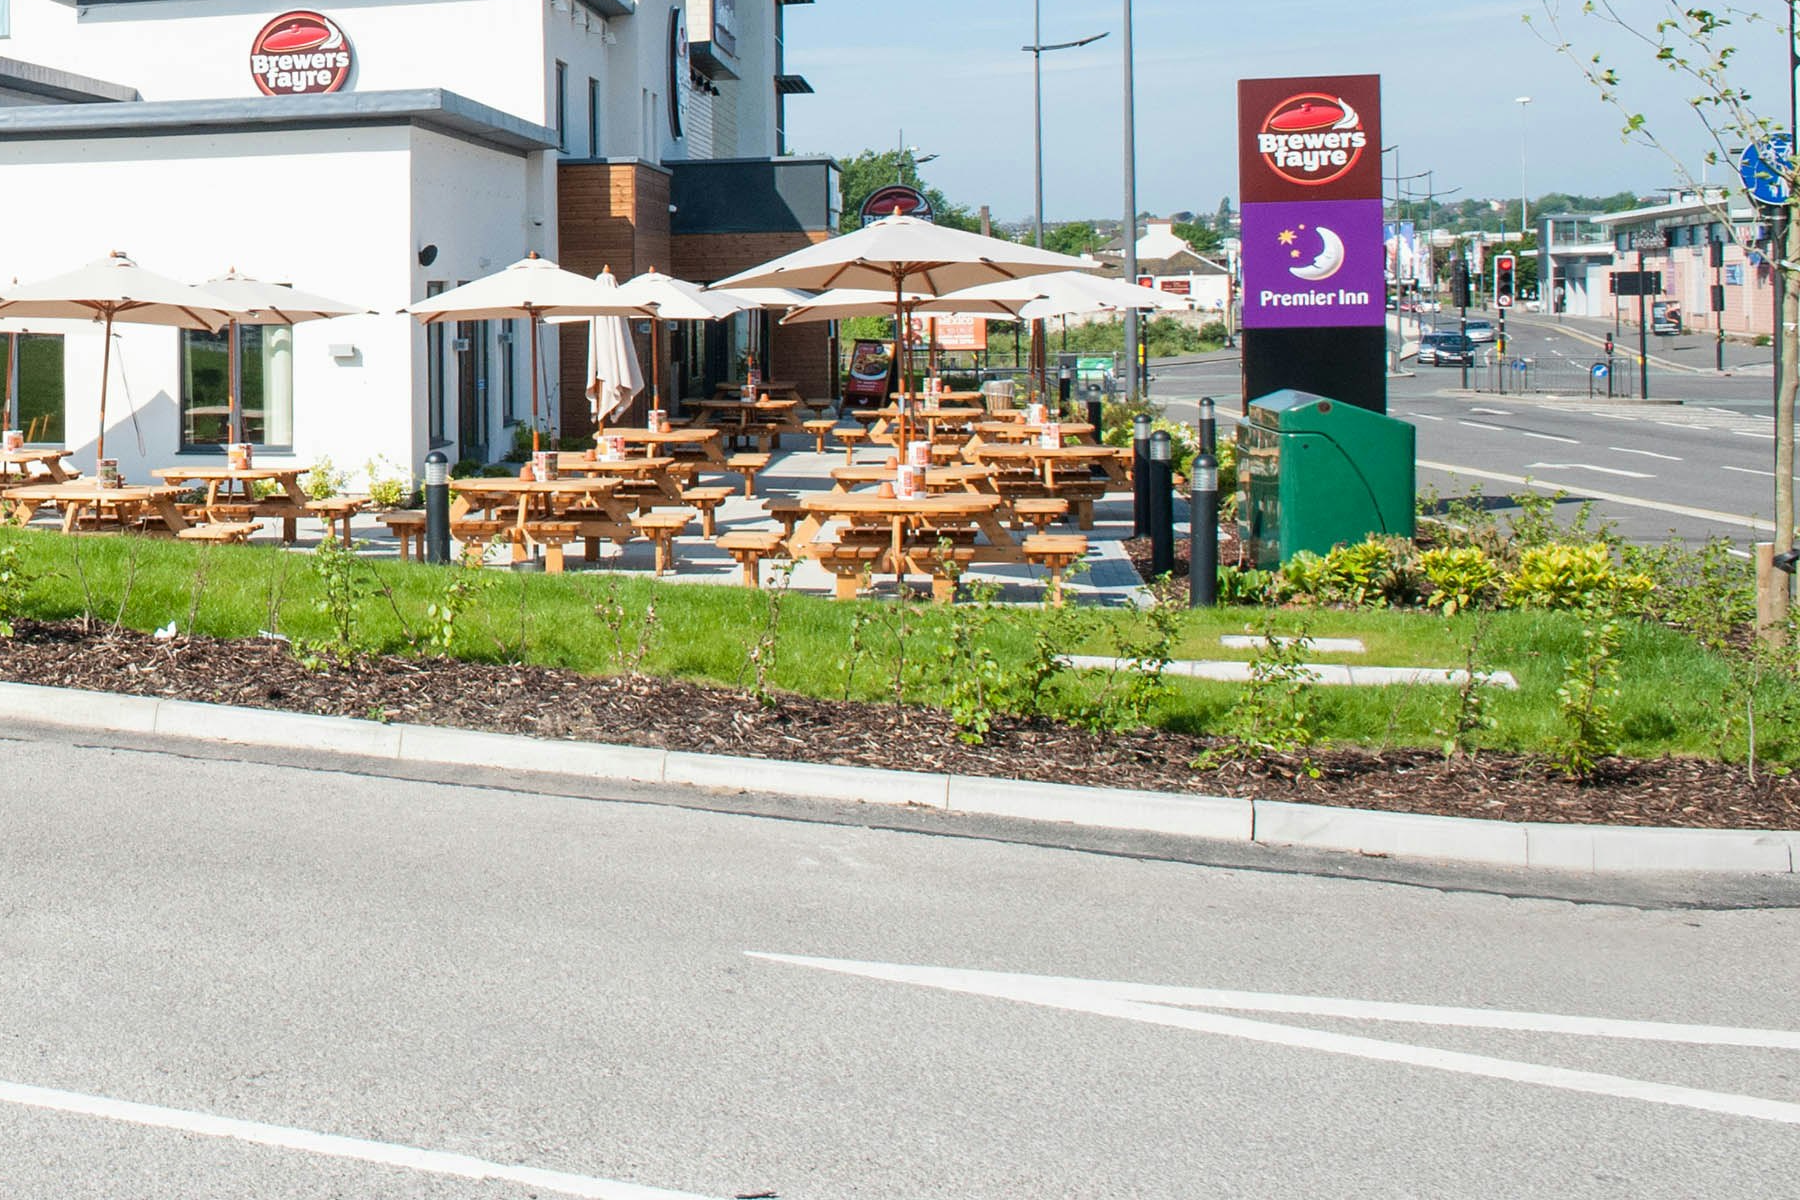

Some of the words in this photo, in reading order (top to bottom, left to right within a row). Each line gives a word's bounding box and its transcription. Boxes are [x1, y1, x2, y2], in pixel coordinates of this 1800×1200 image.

[251, 51, 350, 74] Brewers
[266, 66, 332, 92] fayre
[1257, 131, 1367, 153] Brewers
[1274, 146, 1348, 172] fayre
[1260, 289, 1337, 307] Premier
[1338, 288, 1369, 305] Inn
